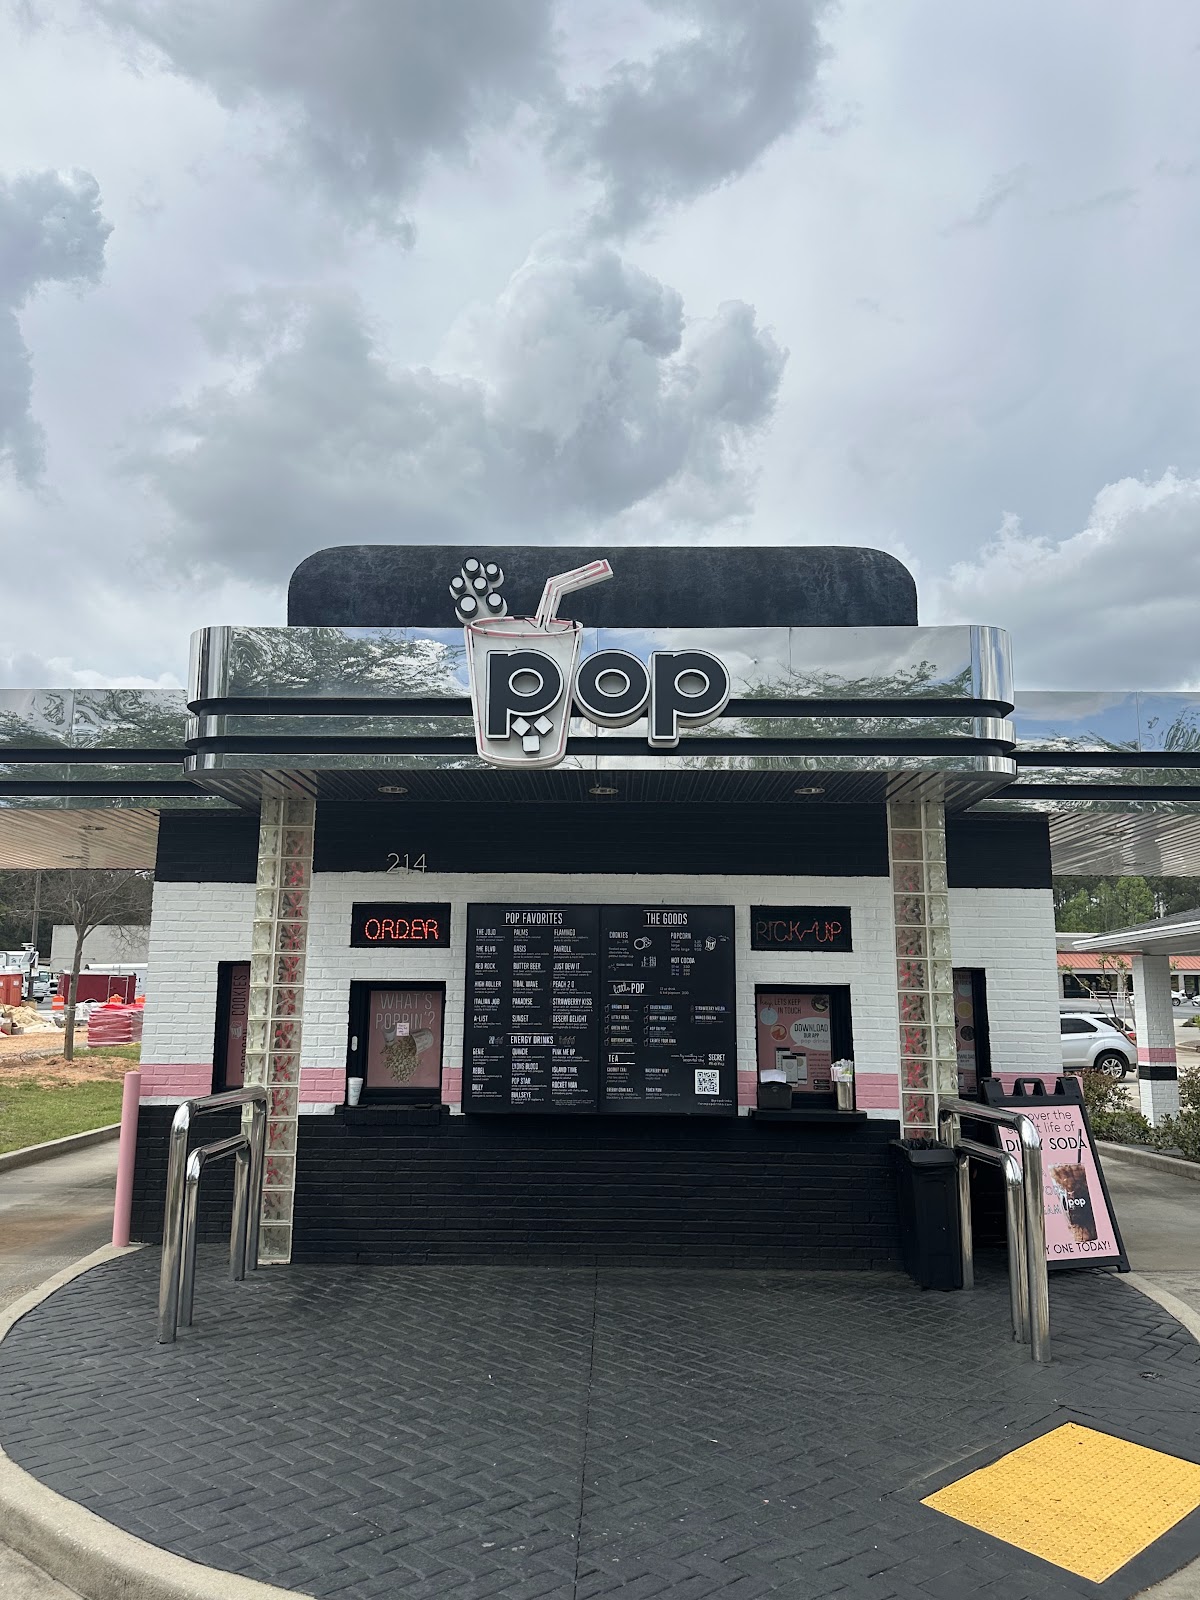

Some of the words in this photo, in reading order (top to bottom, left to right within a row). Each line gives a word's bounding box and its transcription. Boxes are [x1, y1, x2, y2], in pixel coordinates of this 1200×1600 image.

[486, 649, 730, 745] pop
[386, 853, 427, 874] 214
[505, 912, 520, 924] POP
[522, 912, 563, 924] FAVORITES
[646, 913, 660, 924] THE
[663, 913, 688, 924] GOODS
[365, 919, 438, 940] ORDER
[631, 983, 644, 993] POP
[232, 974, 247, 1016] COOKIES
[381, 993, 432, 1009] WHAT'S
[794, 1024, 828, 1032] DOWNLOAD
[510, 1036, 532, 1044] ENERGY
[533, 1036, 554, 1044] DRINKS
[1053, 1109, 1072, 1120] the
[1044, 1122, 1060, 1132] life
[1064, 1121, 1075, 1132] of
[1050, 1137, 1087, 1150] SODA
[1068, 1198, 1086, 1208] pop
[1054, 1244, 1074, 1254] ONE
[1076, 1241, 1110, 1252] TODAY!
